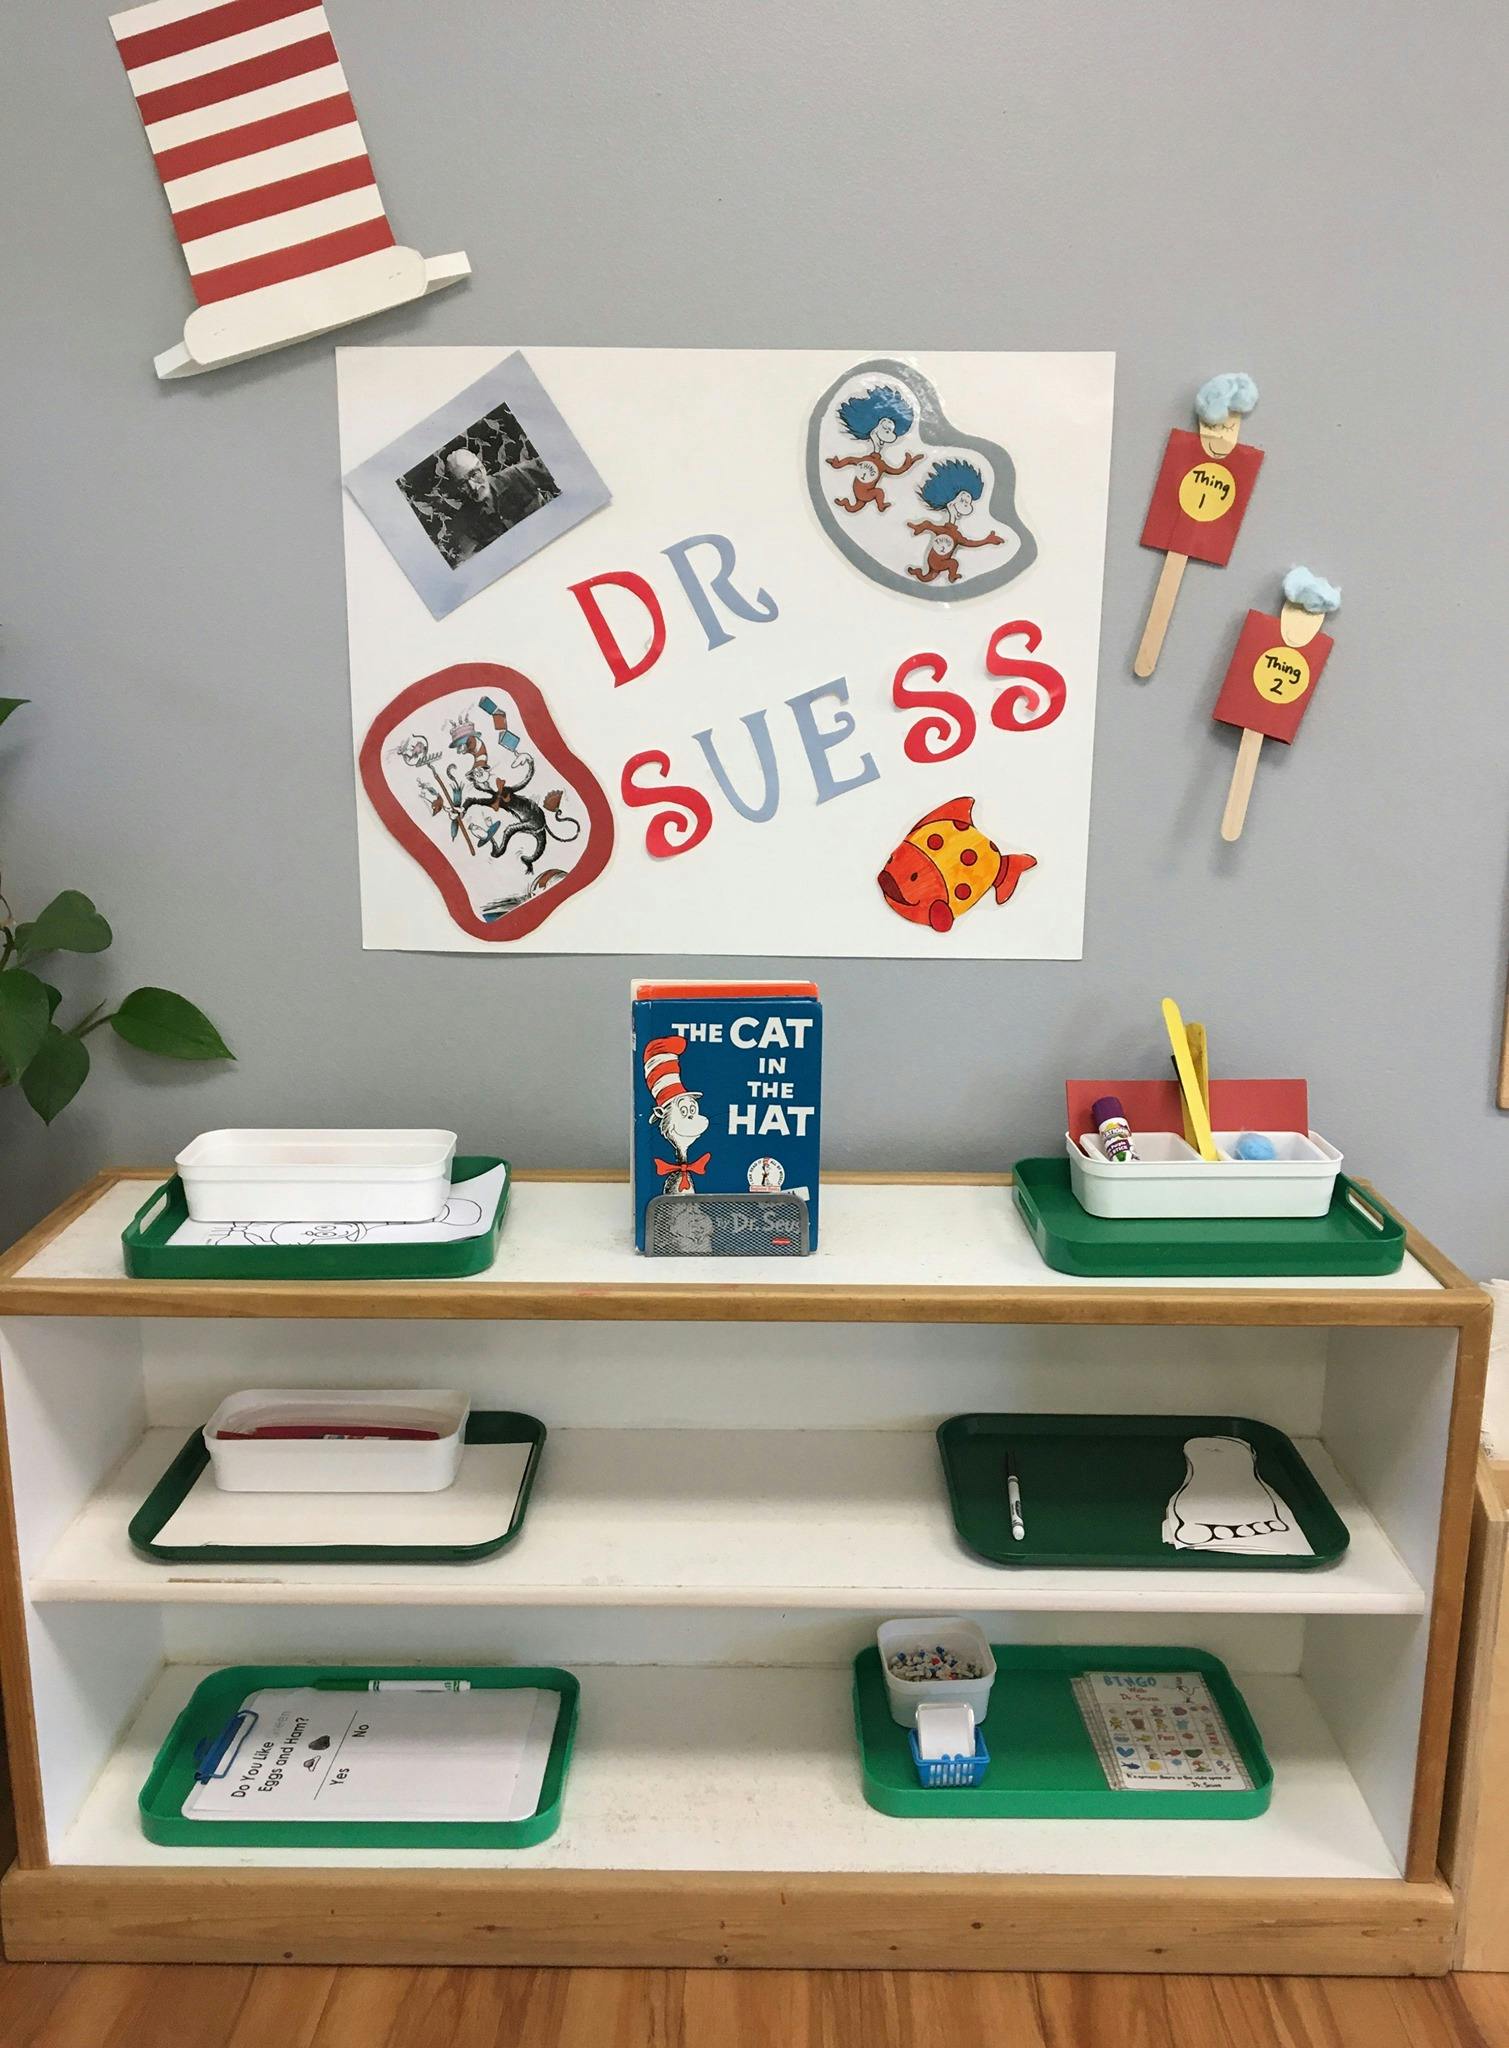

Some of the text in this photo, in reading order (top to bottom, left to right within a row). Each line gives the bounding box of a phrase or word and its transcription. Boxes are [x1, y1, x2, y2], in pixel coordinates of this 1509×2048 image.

[1193, 470, 1230, 500] Thing
[1198, 493, 1206, 509] 1
[567, 533, 779, 688] DR
[1264, 654, 1301, 685] Thing
[1269, 678, 1284, 695] 2
[620, 619, 1067, 859] SUESS
[671, 1016, 813, 1049] THE CAT
[759, 1057, 786, 1074] IN
[747, 1081, 794, 1099] THE
[728, 1104, 815, 1136] HAT
[1103, 1675, 1157, 1687] BINGO
[352, 1724, 370, 1738] No
[231, 1784, 250, 1798] Do
[241, 1762, 263, 1782] You
[253, 1741, 275, 1761] Like
[258, 1717, 310, 1792] Eggs and Ham?
[329, 1768, 350, 1786] Yes
